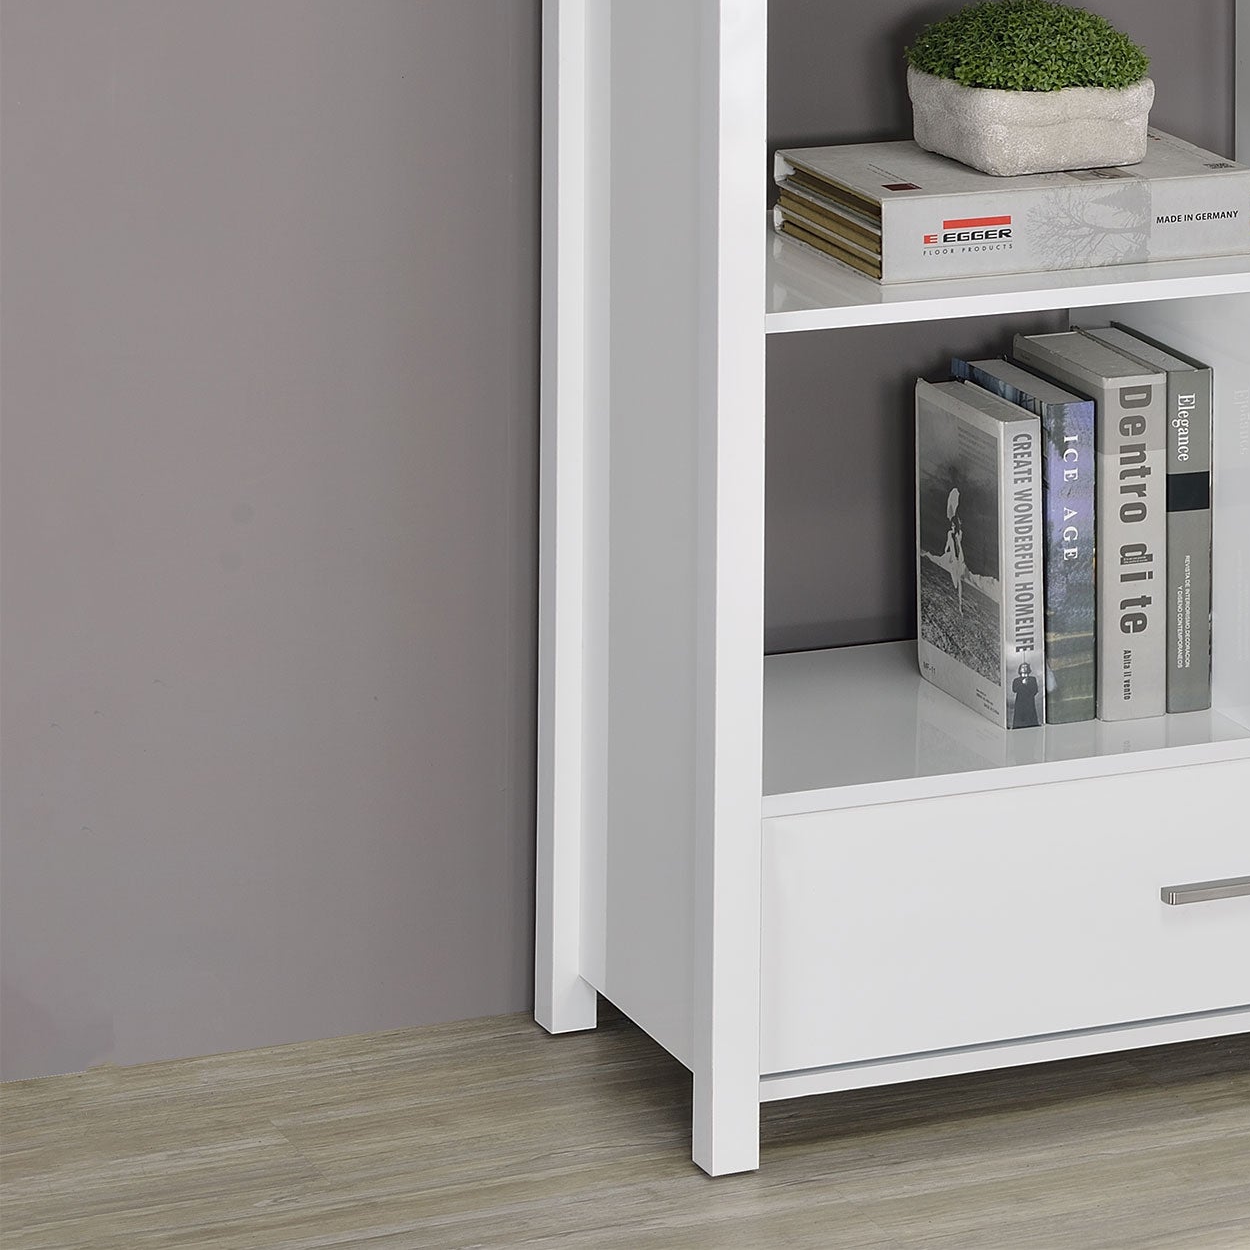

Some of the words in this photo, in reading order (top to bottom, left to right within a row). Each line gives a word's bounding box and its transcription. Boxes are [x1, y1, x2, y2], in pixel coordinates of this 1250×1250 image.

[942, 228, 1012, 243] EGGER
[1156, 214, 1182, 224] MADE
[1184, 213, 1194, 222] IN
[1195, 210, 1239, 221] GERMANY
[923, 248, 954, 256] FLOOR
[961, 243, 1013, 253] PRODUCTS
[1171, 393, 1196, 462] Elegance
[1012, 433, 1033, 485] CREATE
[1063, 435, 1079, 482] ICE
[1119, 384, 1152, 524] Dentro
[1013, 487, 1034, 578] WONDERFUL
[1063, 507, 1079, 561] AGE
[1119, 543, 1154, 583] di
[1014, 583, 1035, 653] HOMELIFE
[1119, 595, 1152, 634] te
